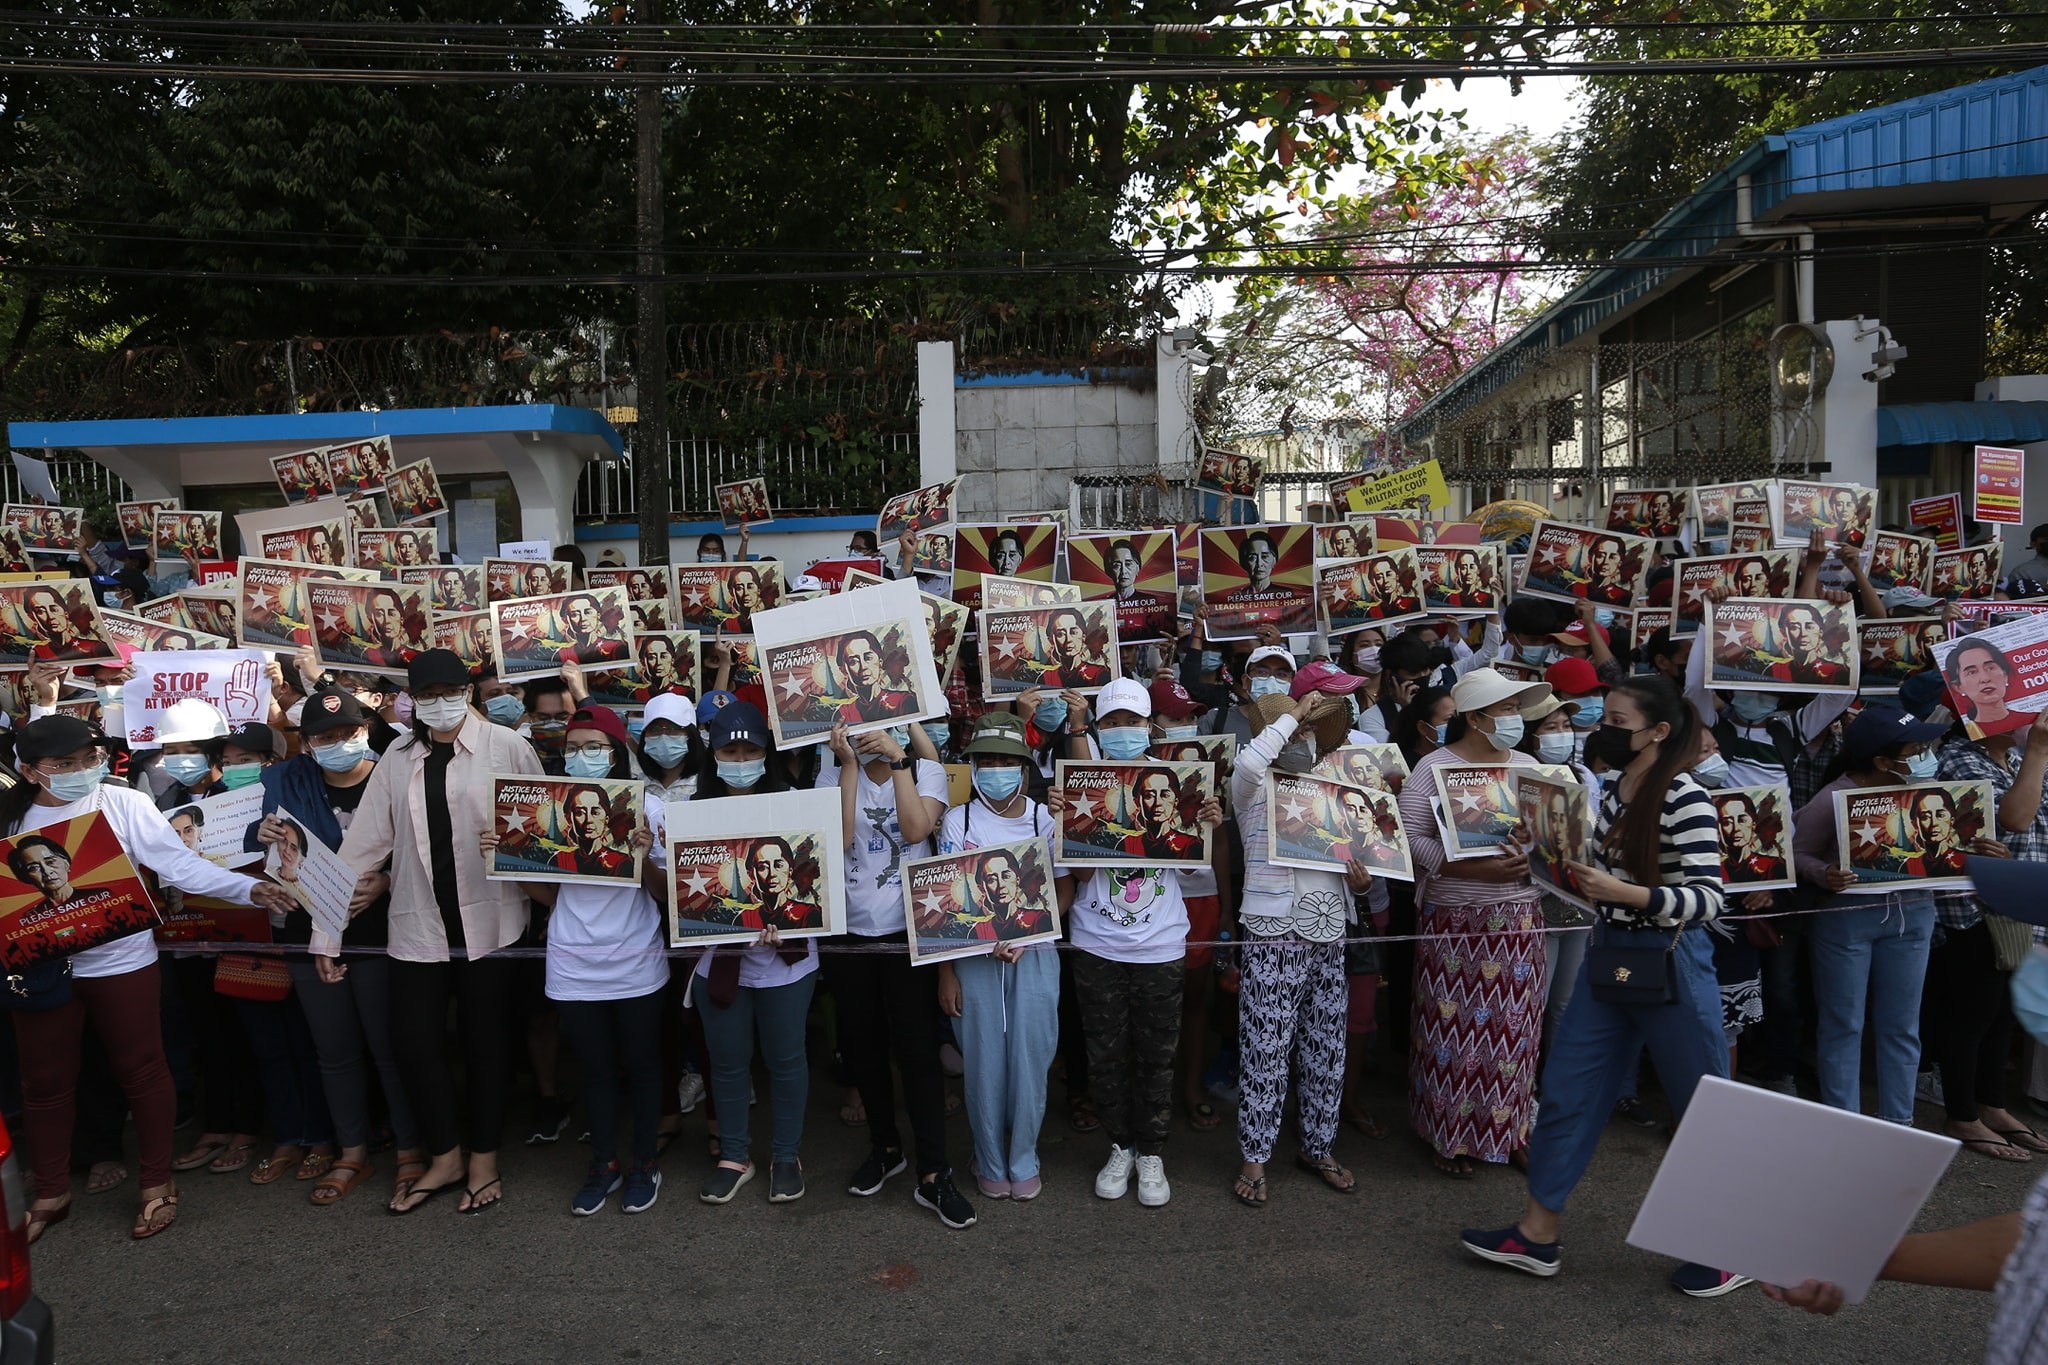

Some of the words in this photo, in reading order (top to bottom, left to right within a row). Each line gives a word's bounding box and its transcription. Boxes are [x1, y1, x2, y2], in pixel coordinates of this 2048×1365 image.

[1360, 486, 1374, 497] We
[1376, 477, 1398, 492] Don't
[1400, 467, 1427, 485] Accept
[1364, 487, 1403, 506] MILITARY
[1405, 477, 1427, 491] COUP
[1786, 490, 1821, 498] MYANMAR
[1544, 528, 1565, 536] JUSTICE
[266, 537, 285, 545] JUSTICE
[1541, 534, 1582, 546] MYANMAR
[266, 541, 300, 552] MYANMAR
[250, 567, 275, 575] JUSTICE
[276, 570, 290, 578] FOR
[1325, 570, 1343, 578] JUSTICE
[1683, 571, 1724, 580] MYANMAR
[247, 574, 292, 586] MYANMAR
[403, 575, 431, 583] MYANMAR
[681, 576, 718, 584] MYANMAR
[990, 587, 1023, 597] MYANMAR
[1227, 594, 1253, 602] PLEASE
[1254, 592, 1274, 600] SAVE
[1275, 591, 1292, 599] OUR
[312, 594, 353, 605] MYANMAR
[1119, 600, 1139, 608] SAVE
[1141, 598, 1156, 606] OUR
[1215, 603, 1244, 611] LEADER
[1249, 600, 1280, 609] FUTURE
[1284, 598, 1306, 606] HOPE
[501, 607, 548, 620] MYANMAR
[1147, 605, 1169, 613] HOPE
[1962, 606, 1980, 616] WE
[992, 616, 1016, 624] JUSTICE
[1716, 610, 1765, 621] MYANMAR
[103, 618, 127, 629] JUSTICE
[128, 624, 145, 632] FOR
[990, 622, 1035, 633] MYANMAR
[105, 623, 145, 639] YANMAR
[1864, 631, 1905, 640] MYANMAR
[774, 652, 800, 662] JUSTICE
[802, 646, 818, 655] FOR
[2012, 654, 2031, 664] Our
[772, 654, 822, 671] MYANMAR
[153, 672, 209, 692] STOP
[145, 697, 157, 709] AT
[1104, 694, 1139, 702] PORSCHE
[1070, 771, 1099, 779] JUSTICE
[1101, 771, 1116, 779] FOR
[1066, 779, 1119, 788] MYANMAR
[1279, 779, 1304, 788] JUSTICE
[1447, 777, 1494, 787] MYANMAR
[501, 785, 530, 794] JUSTICE
[1277, 785, 1324, 797] MYANMAR
[498, 793, 550, 805] MYANMAR
[1853, 798, 1878, 807] JUSTICE
[1880, 797, 1894, 805] FOR
[1851, 805, 1897, 817] MYANMAR
[681, 847, 710, 856] JUSTICE
[712, 845, 727, 853] FOR
[678, 853, 731, 866] MYANMAR
[915, 866, 941, 877] JUSTICE
[943, 863, 957, 872] FOR
[913, 871, 961, 887] MYANMAR
[19, 909, 56, 927] PLEASE
[57, 899, 87, 914] SAVE
[88, 890, 111, 904] OUR
[6, 921, 50, 941] LEADER
[55, 906, 98, 925] FUTURE
[103, 893, 133, 908] HOPE
